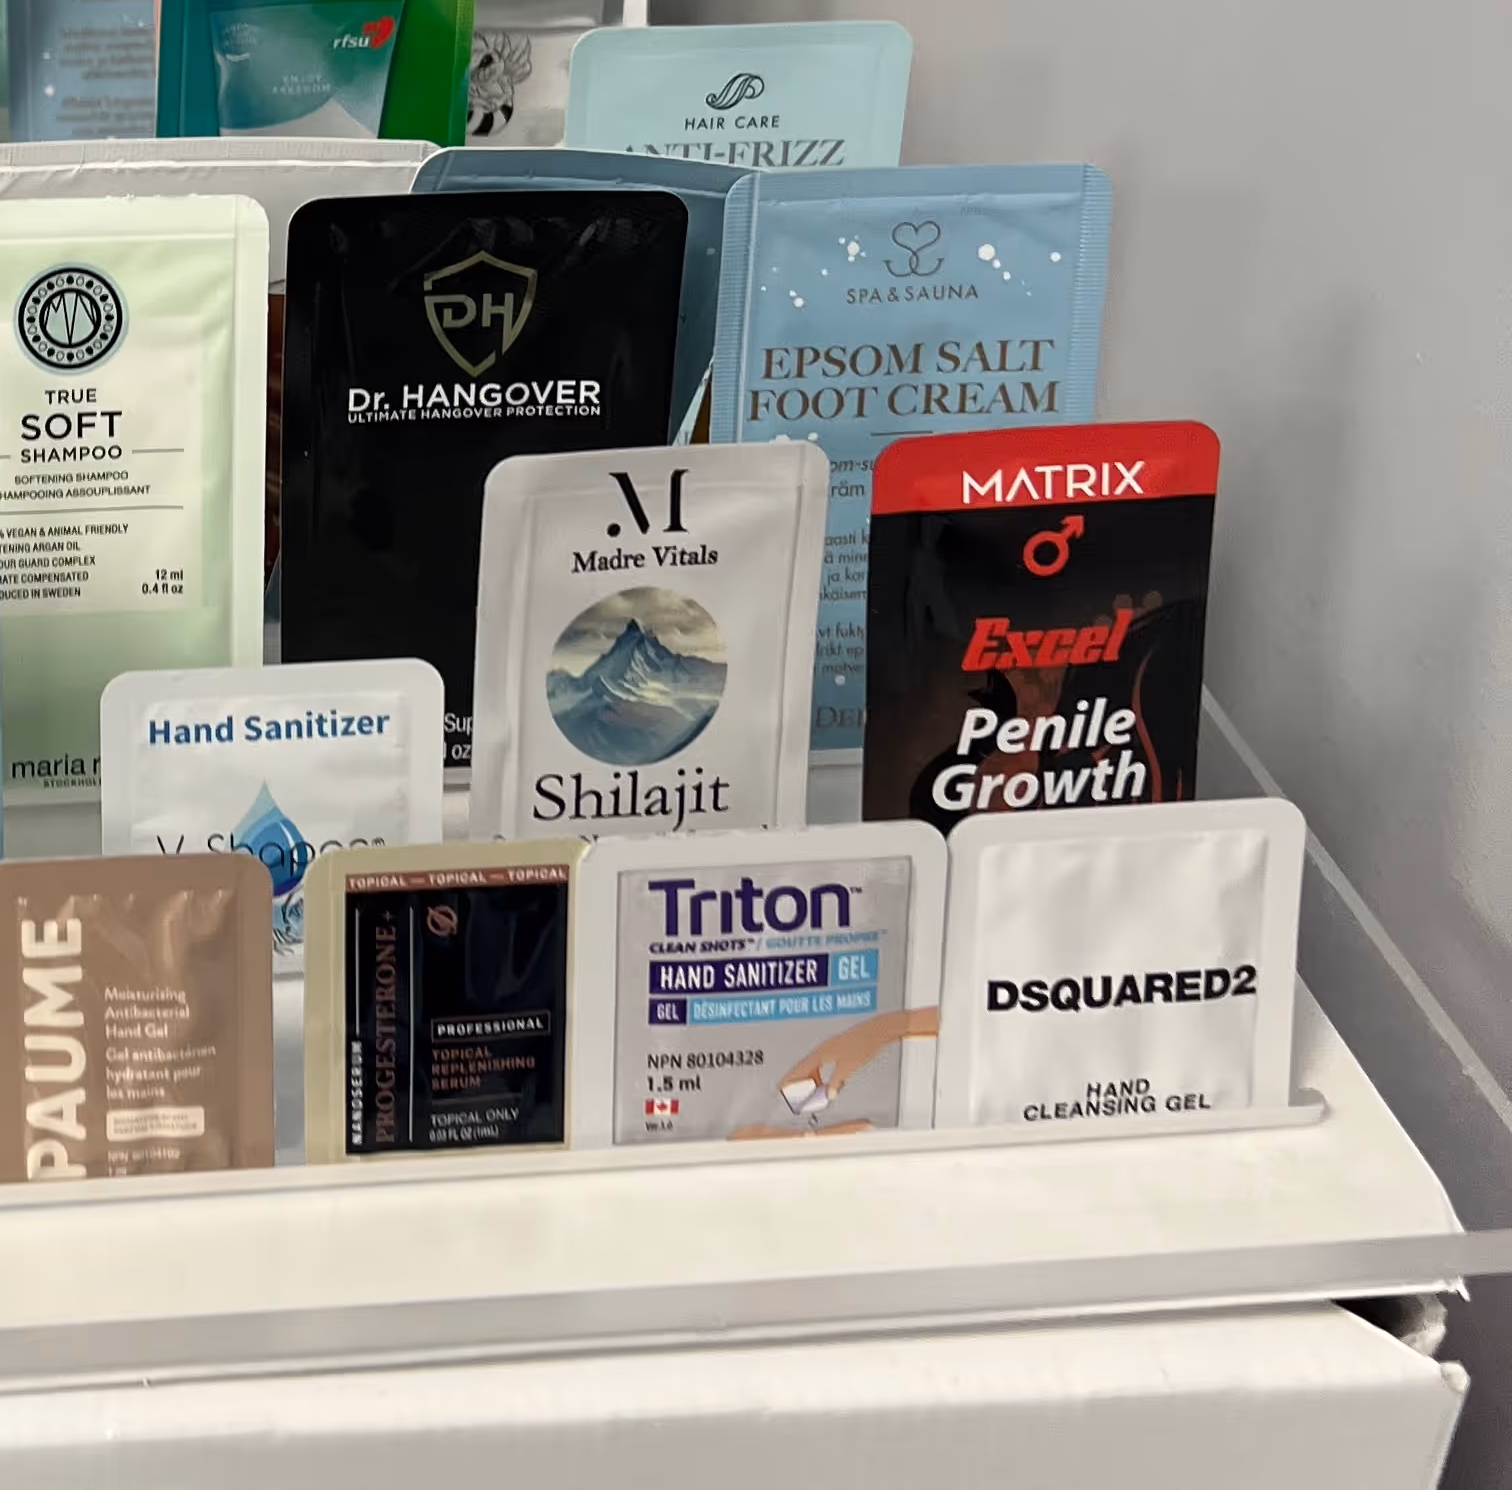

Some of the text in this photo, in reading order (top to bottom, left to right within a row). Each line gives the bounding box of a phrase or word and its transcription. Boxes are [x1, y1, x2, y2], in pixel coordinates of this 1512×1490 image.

[333, 34, 370, 50] rfsu
[684, 114, 781, 131] HAIR CARE
[846, 283, 979, 305] SPA SAUNA
[761, 338, 1056, 381] EPSOM SALT
[45, 388, 97, 405] TRUE
[348, 379, 601, 412] Dr. HANGOVER
[746, 380, 1061, 423] FOOT CREAM
[348, 404, 601, 424] ULTIMATE HANGOVER PROTECTION
[21, 410, 123, 441] SOFT
[20, 445, 123, 463] SHAMPOO
[14, 470, 129, 486] SOFTENING SHAMPOO
[961, 461, 1145, 504] MATRIX
[6, 523, 129, 539] VEGAN ANIMAL FRIENDLY
[32, 541, 64, 553] ARGAN
[18, 555, 96, 569] GUARD COMPLEX
[571, 544, 719, 574] Madre Vitals
[20, 571, 89, 584] COMPENSATED
[155, 568, 184, 581] 12 ml
[42, 587, 81, 598] SWEDEN
[141, 582, 184, 595] 0.4 oz
[961, 608, 1135, 672] Excel
[148, 710, 391, 745] Hand Sanitizer
[957, 697, 1137, 755] Penile
[11, 753, 85, 779] maria
[43, 778, 101, 788] STOCKHOL
[931, 751, 1148, 810] Growth
[533, 767, 731, 831] Shilajit
[350, 867, 567, 890] TOPICAL TOPICAL TOPICAL
[649, 940, 698, 954] CLEAN
[660, 956, 870, 990] HAND SANITIZER GEL
[987, 964, 1257, 1013] DSQUARED2
[105, 1006, 189, 1019] Antibacterial
[657, 991, 871, 1021] GEL POUR LES MAINS
[106, 1023, 168, 1039] Hand Gel
[375, 925, 397, 1142] PROGESTERONE
[437, 1016, 544, 1037] PROFESSIONAL
[21, 917, 87, 1181] PAUME
[106, 1047, 129, 1062] Gel
[432, 1045, 492, 1060] TOPICAL
[647, 1050, 764, 1070] NPN 80104328
[107, 1065, 201, 1083] hydratant pour
[646, 1075, 702, 1092] 1.5 ml
[1087, 1078, 1151, 1099] HAND
[431, 1107, 519, 1128] TOPICAL ONLY
[1023, 1093, 1212, 1122] CLEANSING GEL
